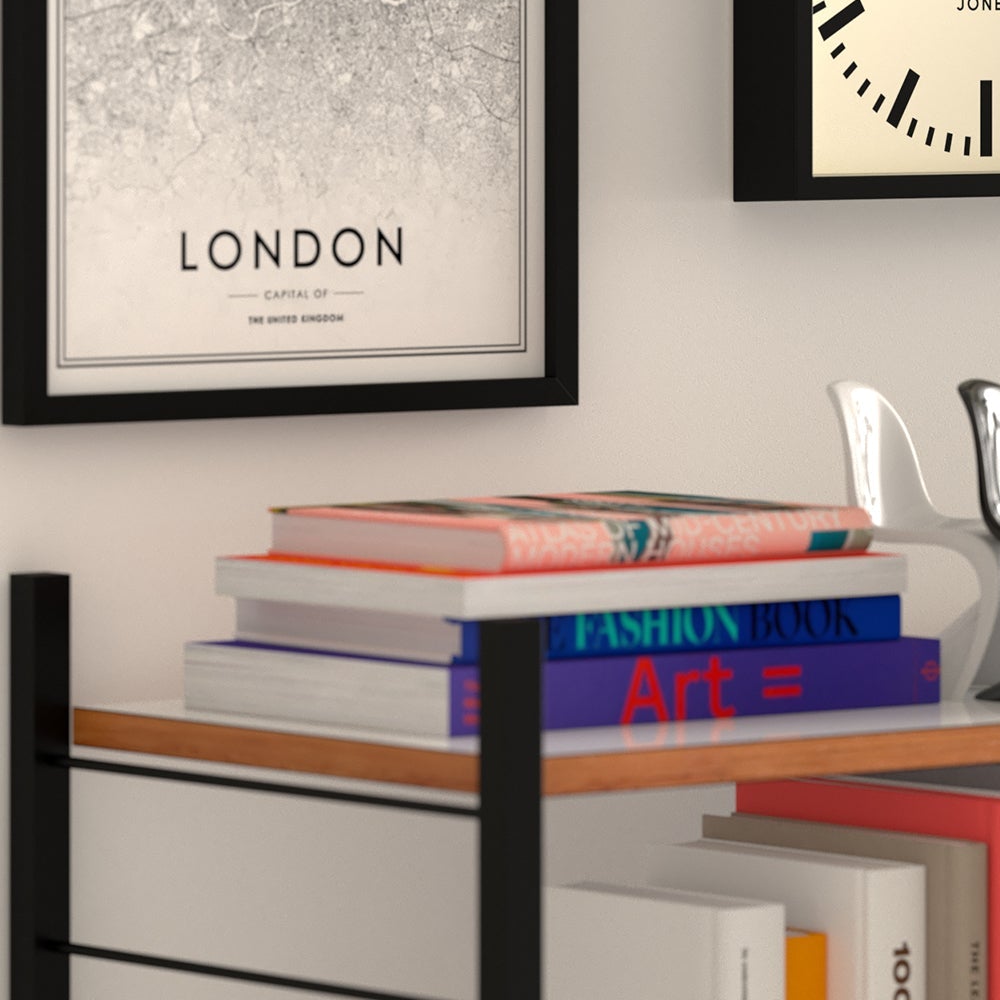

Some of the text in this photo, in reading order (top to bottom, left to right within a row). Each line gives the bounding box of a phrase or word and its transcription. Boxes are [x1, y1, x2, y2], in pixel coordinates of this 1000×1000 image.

[180, 226, 403, 271] LONDON
[263, 288, 329, 301] CAPITAL OF
[248, 313, 344, 325] THE UNITED KINGDOM
[604, 519, 641, 541] OF
[575, 604, 740, 651] FASHION
[751, 597, 859, 641] BOOK
[621, 655, 736, 725] Art
[970, 941, 981, 974] THE
